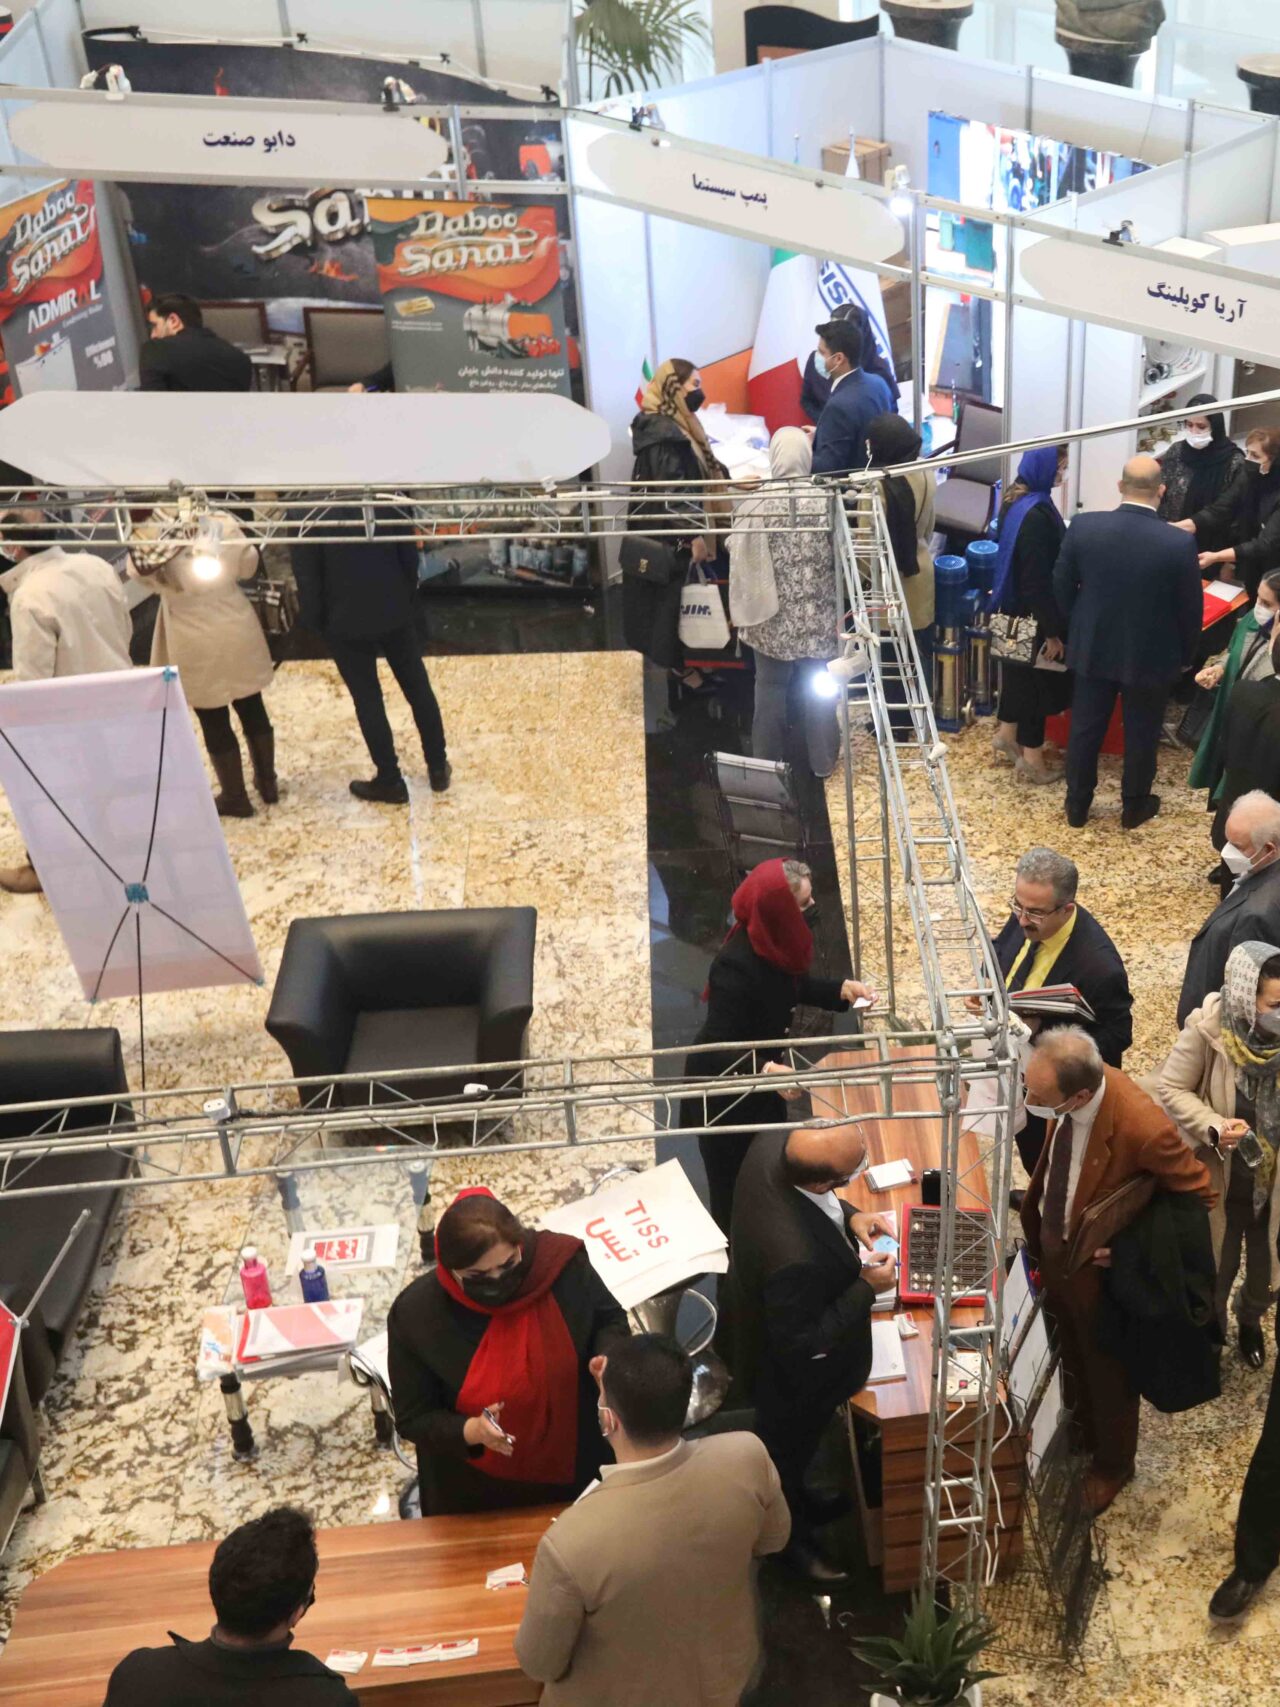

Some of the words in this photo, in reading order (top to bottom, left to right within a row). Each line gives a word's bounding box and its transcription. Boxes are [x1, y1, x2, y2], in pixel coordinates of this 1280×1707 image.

[203, 130, 256, 148] صنعت
[263, 129, 296, 153] دابو
[692, 173, 736, 201] سیستما
[740, 190, 768, 211] پمپ
[12, 190, 76, 250] Daboo
[410, 211, 518, 240] Daboo
[11, 203, 91, 295] Sanat
[398, 227, 538, 277] Sanat
[27, 279, 102, 335] ADMIRAL
[1146, 281, 1210, 313] کوپلینگ
[1213, 294, 1248, 323] آریا
[585, 1217, 640, 1262] تیس
[625, 1199, 670, 1249] TISS
